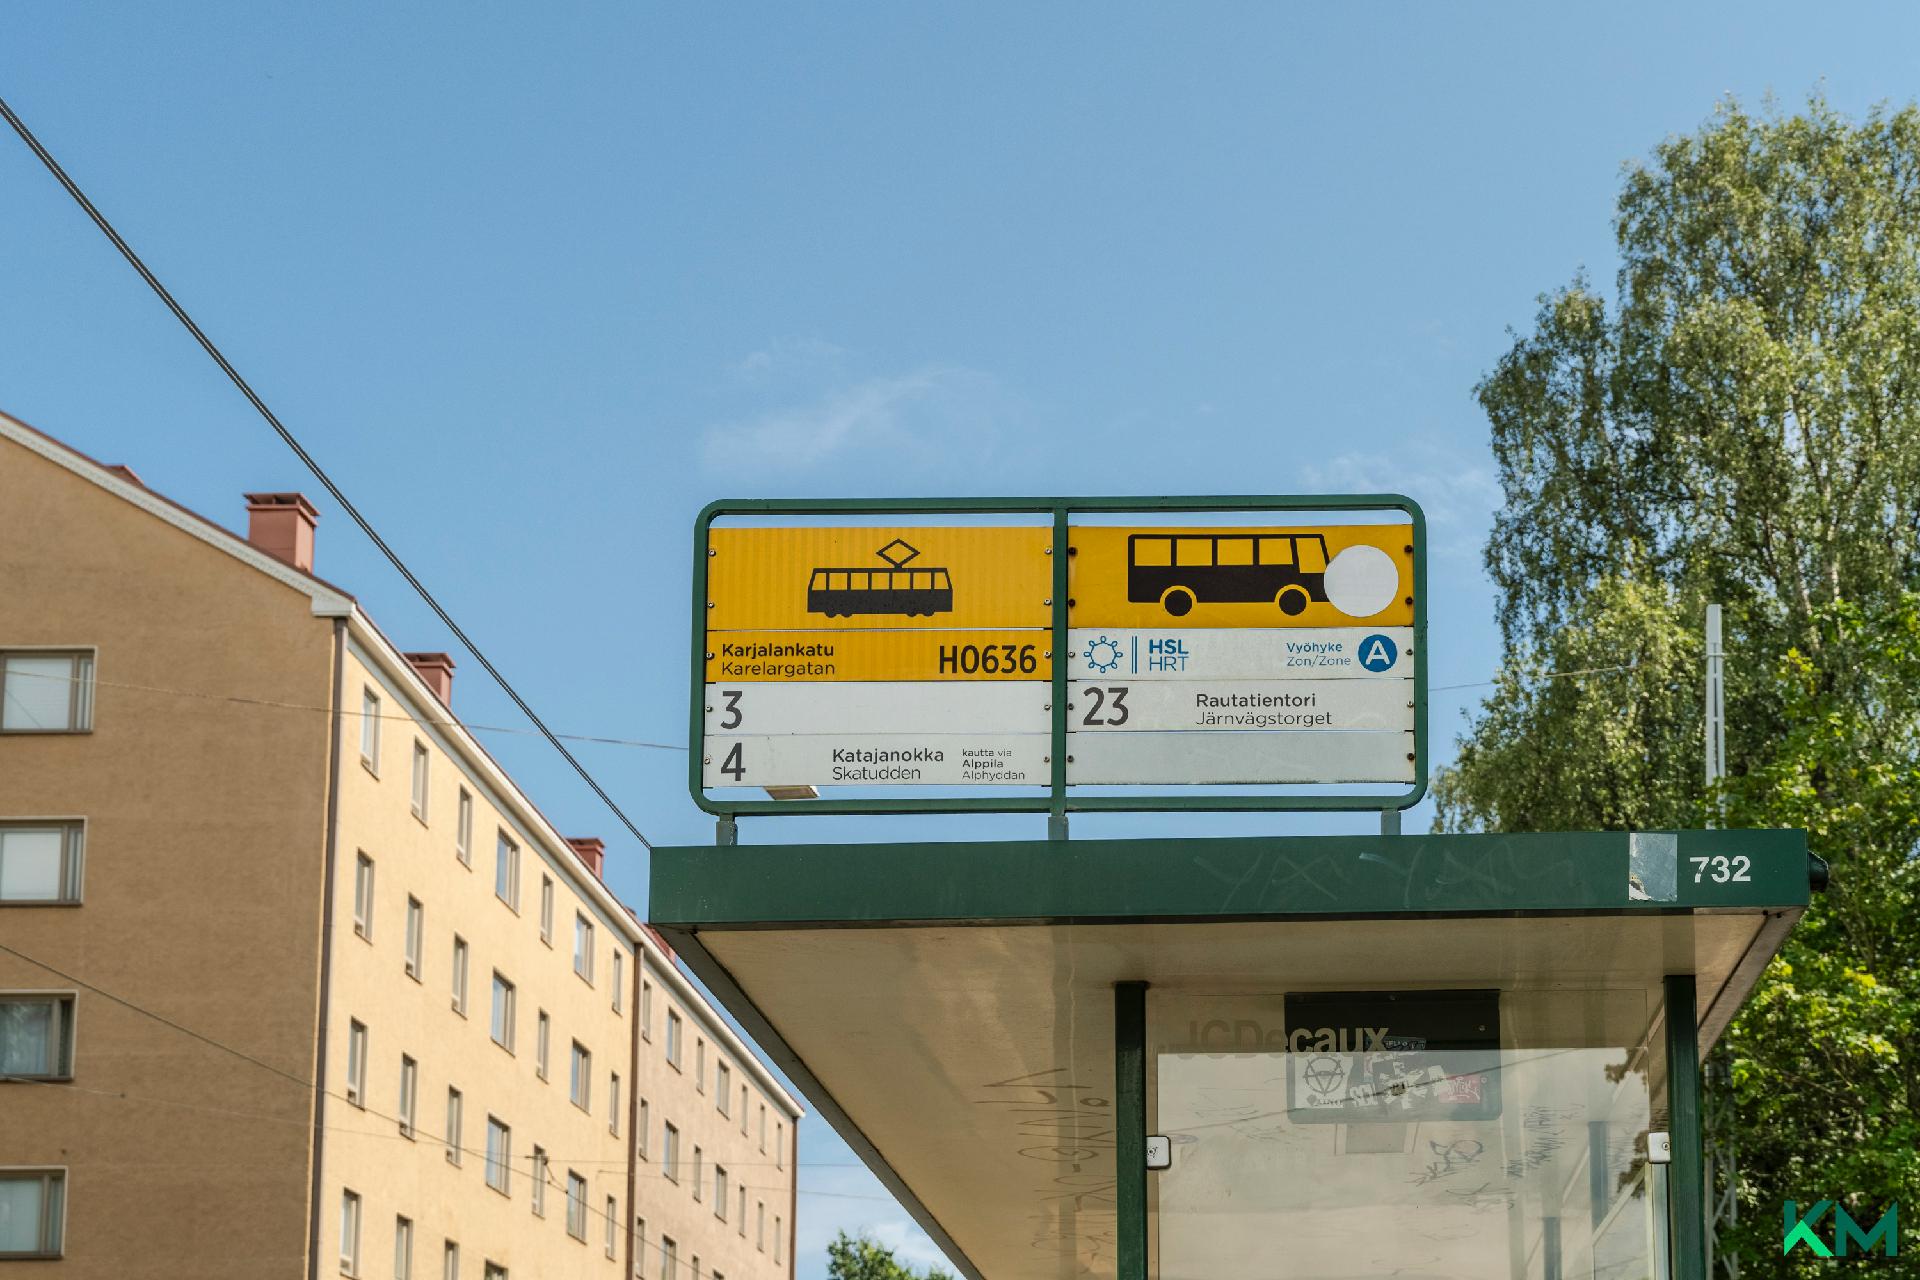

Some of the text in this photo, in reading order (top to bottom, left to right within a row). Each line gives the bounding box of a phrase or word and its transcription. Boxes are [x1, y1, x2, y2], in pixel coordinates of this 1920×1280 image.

[723, 643, 833, 659] Karjalankatu
[1149, 639, 1189, 654] HSL
[1287, 643, 1342, 656] Vyöhyke
[1150, 656, 1188, 671] HRT
[1287, 655, 1351, 667] Zon/Zone
[722, 661, 834, 677] Karelargatan
[1083, 687, 1128, 726] 23
[1197, 693, 1315, 707] Rautatientori
[721, 691, 742, 729] 3
[1196, 712, 1332, 727] Järnvägstorget
[721, 743, 746, 781] 4
[833, 748, 943, 764] Katajanokka
[963, 759, 1003, 769] Alppila
[833, 766, 920, 780] Skatudden
[963, 771, 1025, 781] Alphyddan
[1690, 855, 1751, 883] 732
